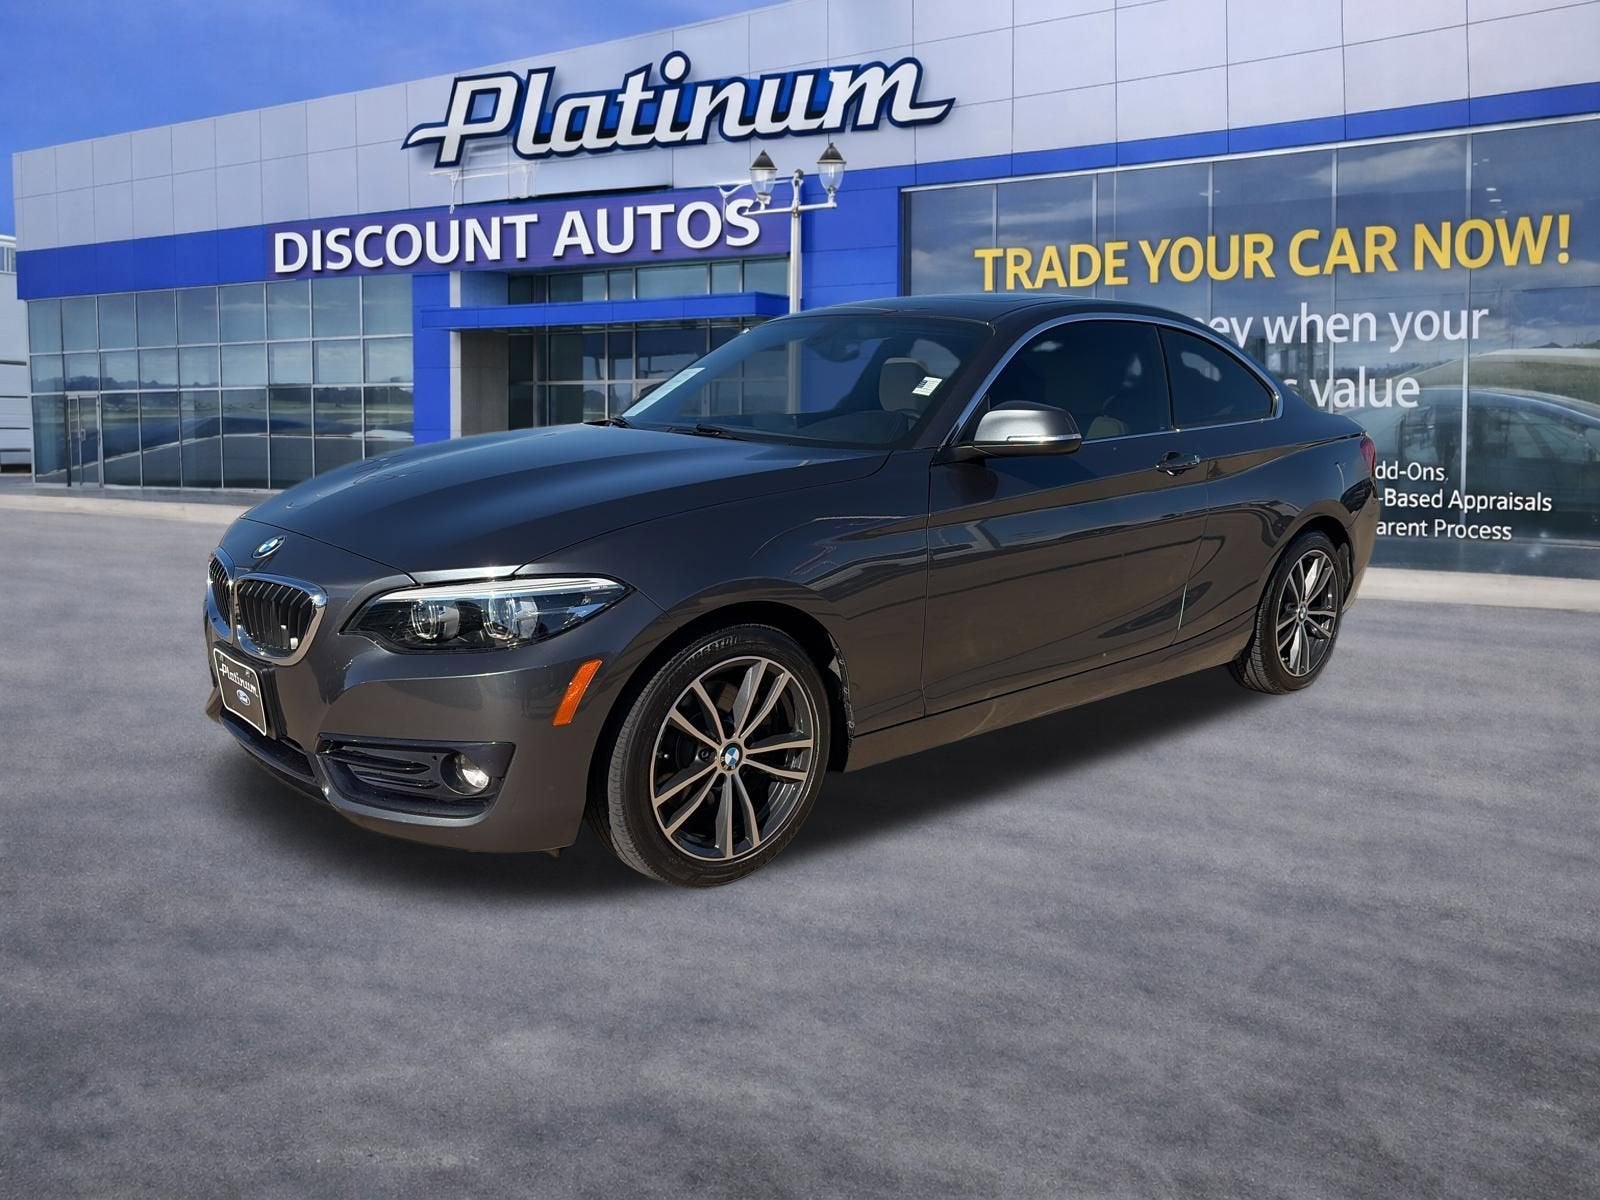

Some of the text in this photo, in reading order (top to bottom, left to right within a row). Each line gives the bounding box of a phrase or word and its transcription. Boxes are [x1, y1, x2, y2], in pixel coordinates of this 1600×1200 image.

[401, 50, 956, 168] Platinum
[273, 197, 762, 275] DISCOUNT AUTOS
[974, 213, 1571, 292] TRADE YOUR CAR NOW!
[1195, 302, 1488, 352] ey when your
[1310, 366, 1420, 408] value
[1448, 489, 1553, 513] Appraisals
[1434, 519, 1512, 541] Process
